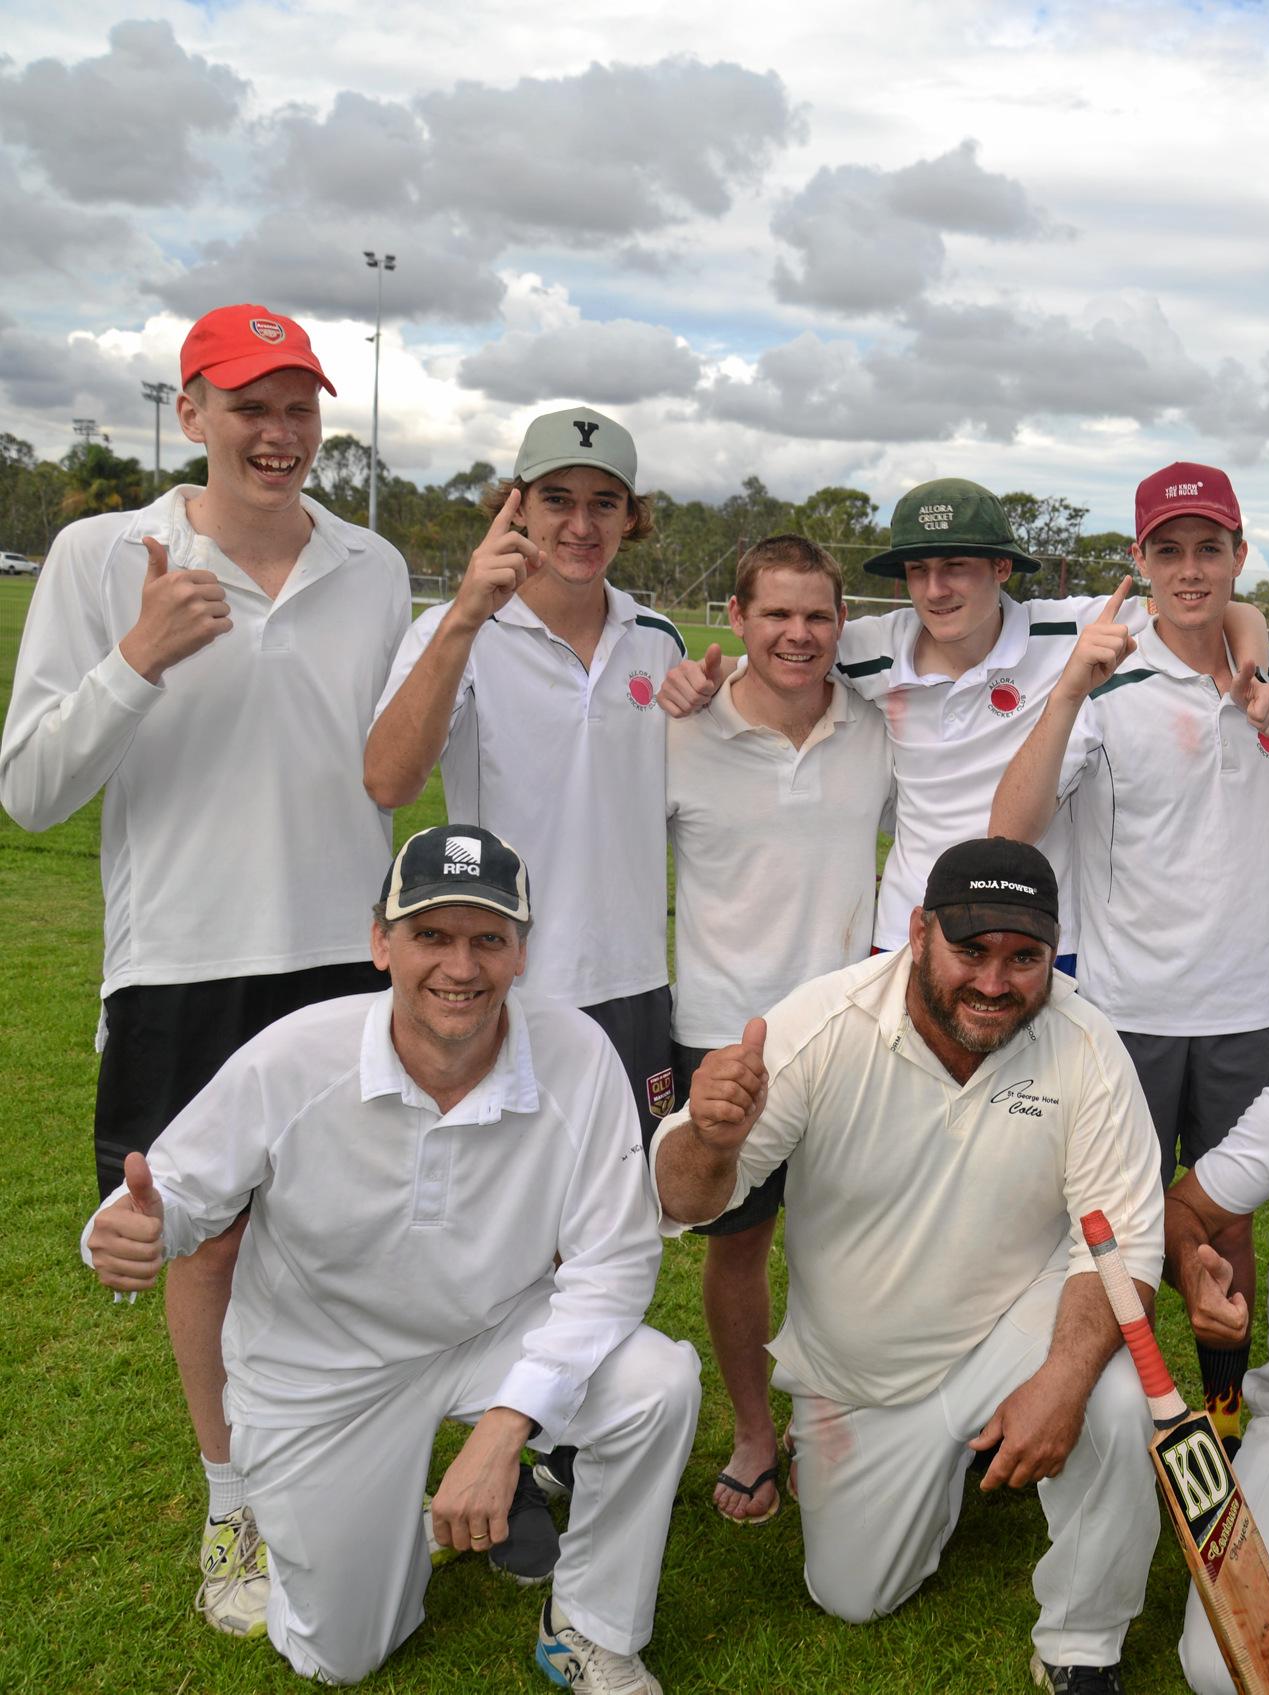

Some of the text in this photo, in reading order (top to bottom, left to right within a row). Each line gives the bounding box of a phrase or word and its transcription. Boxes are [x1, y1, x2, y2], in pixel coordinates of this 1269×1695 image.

[573, 421, 599, 448] Y
[919, 504, 954, 514] ALLORA
[918, 513, 954, 523] CRICKET
[924, 521, 949, 531] CLUB
[989, 677, 1015, 690] ALLORA
[1016, 694, 1027, 712] CLUB
[988, 704, 1014, 718] CRICKET
[443, 862, 481, 877] RPQ
[969, 880, 1000, 889] NOJA
[652, 1077, 671, 1094] QLD
[1007, 1090, 1060, 1105] St George Hotel
[1008, 1101, 1044, 1117] Colts
[1162, 1430, 1229, 1522] KD
